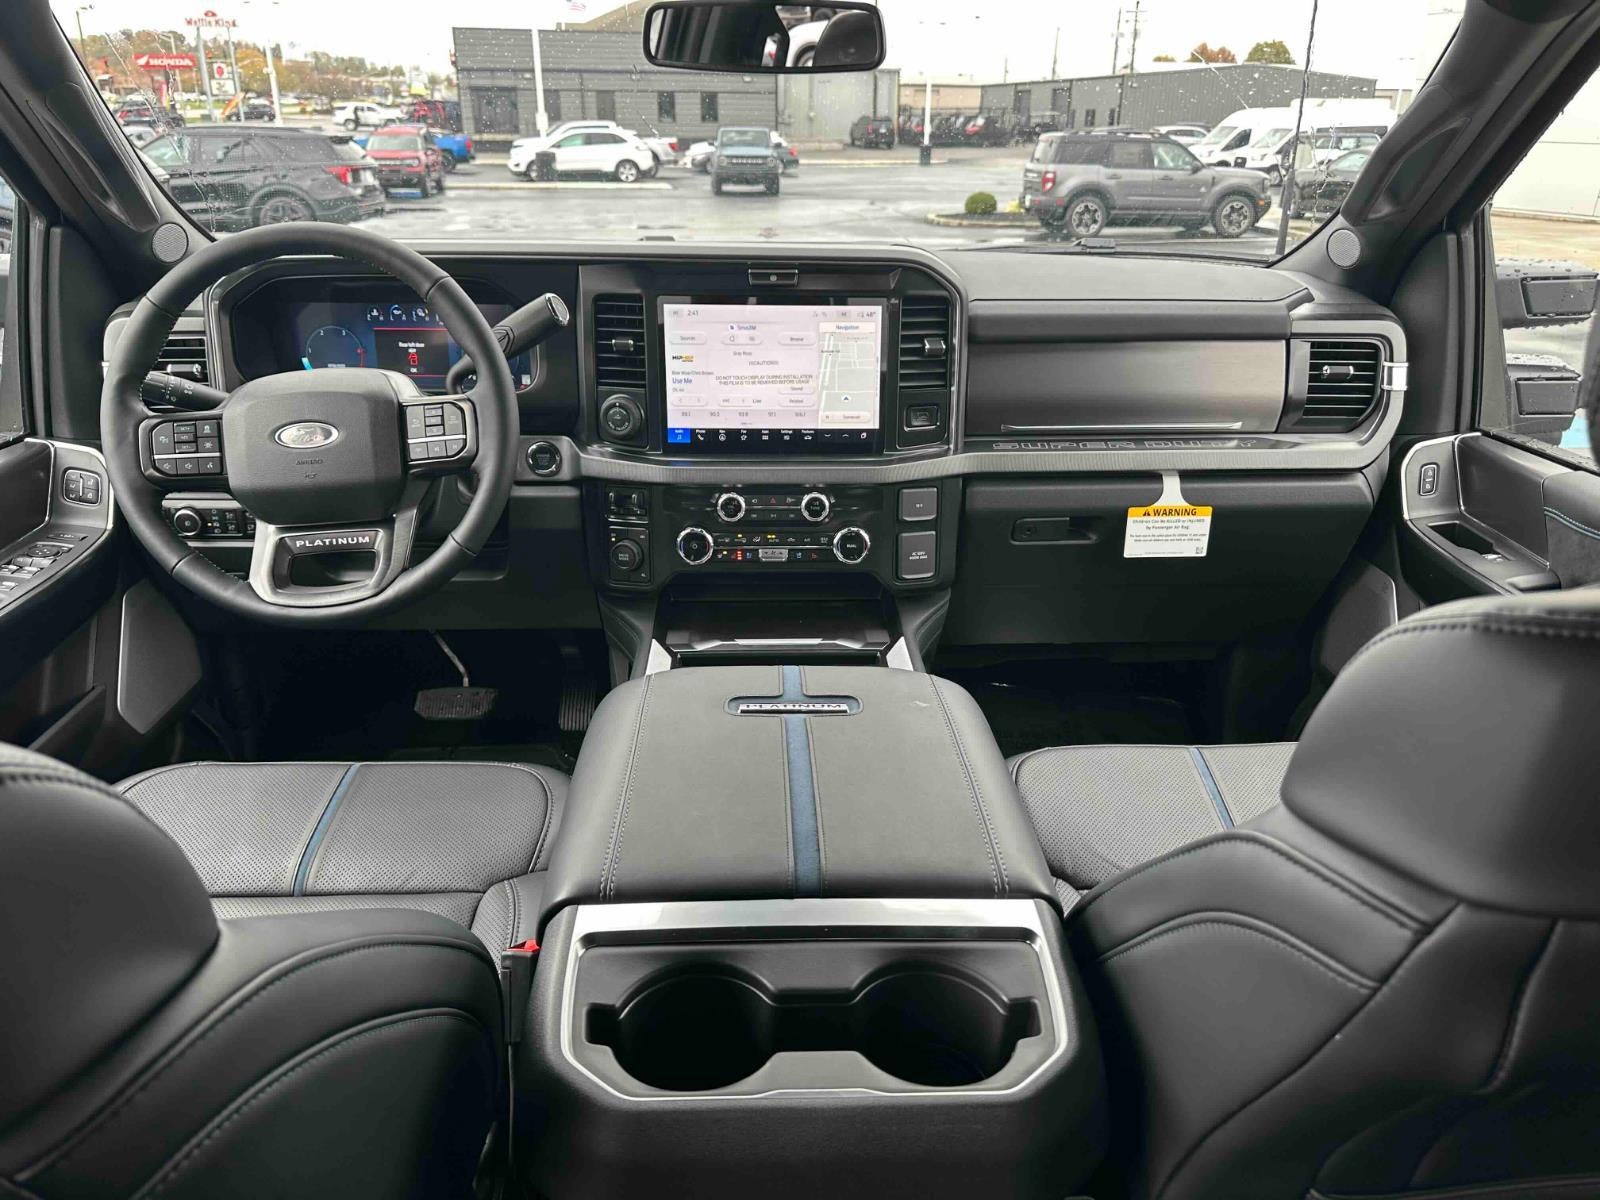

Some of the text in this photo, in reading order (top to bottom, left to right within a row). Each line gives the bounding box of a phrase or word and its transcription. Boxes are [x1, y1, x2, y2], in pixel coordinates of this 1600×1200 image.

[149, 58, 193, 66] HONDA
[993, 441, 1135, 450] SUPER
[1153, 508, 1197, 517] WARNING
[295, 536, 370, 548] PLATINUM
